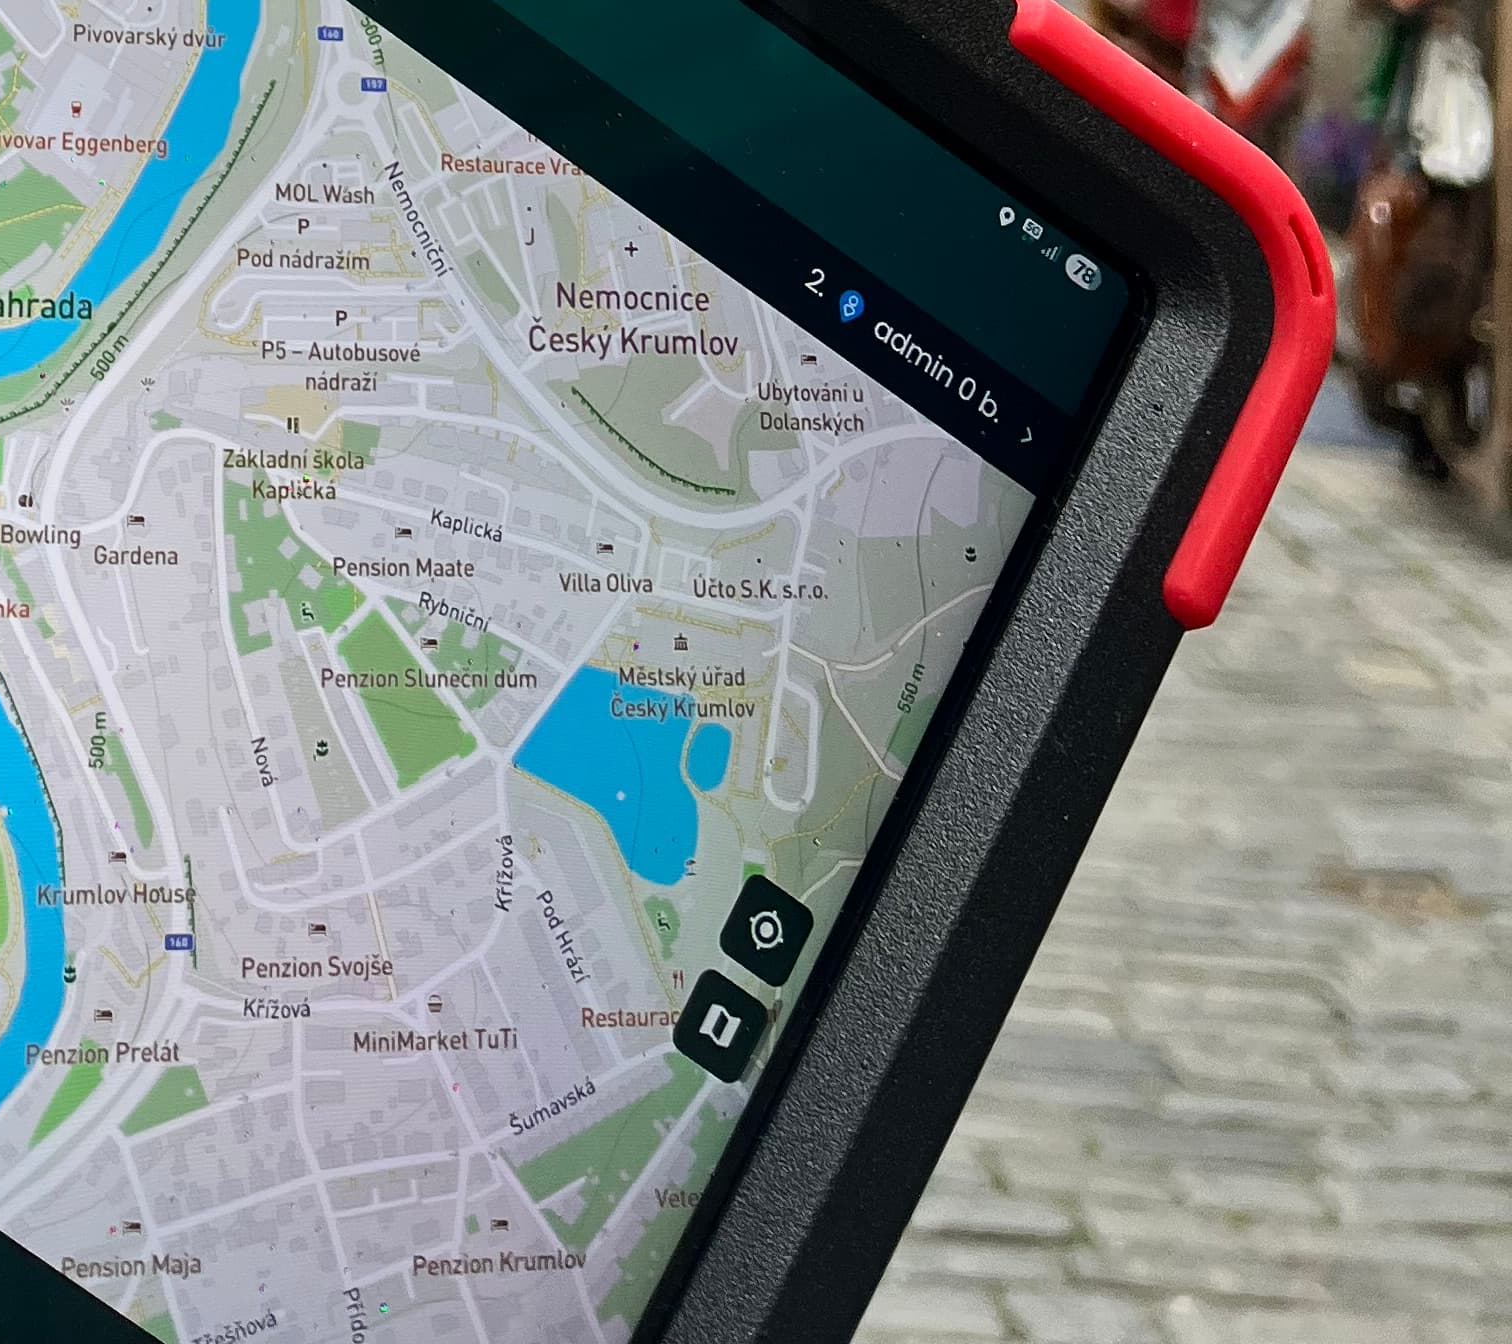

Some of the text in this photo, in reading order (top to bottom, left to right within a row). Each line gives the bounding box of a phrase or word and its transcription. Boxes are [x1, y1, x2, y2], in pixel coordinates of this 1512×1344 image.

[72, 22, 226, 50] Pivovarský dvůr
[62, 133, 169, 160] Eggenberg
[441, 154, 545, 176] Restaurace
[275, 184, 375, 205] MOL Wash
[383, 160, 452, 278] Nemocniční
[237, 248, 370, 272] Pod nádražím
[1072, 259, 1096, 284] 78
[556, 282, 710, 312] Nemocnice
[529, 316, 739, 358] Český Krumlov
[804, 268, 825, 298] 2.
[874, 320, 955, 388] admin
[308, 341, 421, 363] Autobusové
[305, 371, 378, 392] nádraží
[757, 378, 849, 405] Ubytování
[759, 410, 865, 435] Dolanských
[223, 448, 365, 470] Základní škola
[252, 478, 336, 503] Kaplická
[0, 525, 81, 550] Bowling
[430, 507, 503, 543] Kaplická
[93, 545, 178, 566] Gardena
[333, 557, 475, 580] Pension Maate
[559, 573, 653, 595] Villa Oliva
[693, 573, 736, 599] Účto
[418, 591, 491, 633] Rybniční
[321, 666, 537, 690] Penzion Sluneční dům
[619, 665, 746, 692] Městský úřad
[610, 696, 755, 723] Český Krumlov
[252, 737, 274, 787] Nová
[493, 834, 514, 912] Křížová
[37, 883, 196, 906] Krumlov House
[242, 955, 393, 982] Penzion Svojše
[243, 996, 311, 1020] Křížová
[26, 1042, 180, 1066] Penzion Prelát
[353, 1028, 518, 1054] MiniMarket TuTi
[509, 1077, 597, 1136] Šumavská
[61, 1253, 202, 1280] Pension Maja
[412, 1249, 587, 1277] Penzion Krumlov
